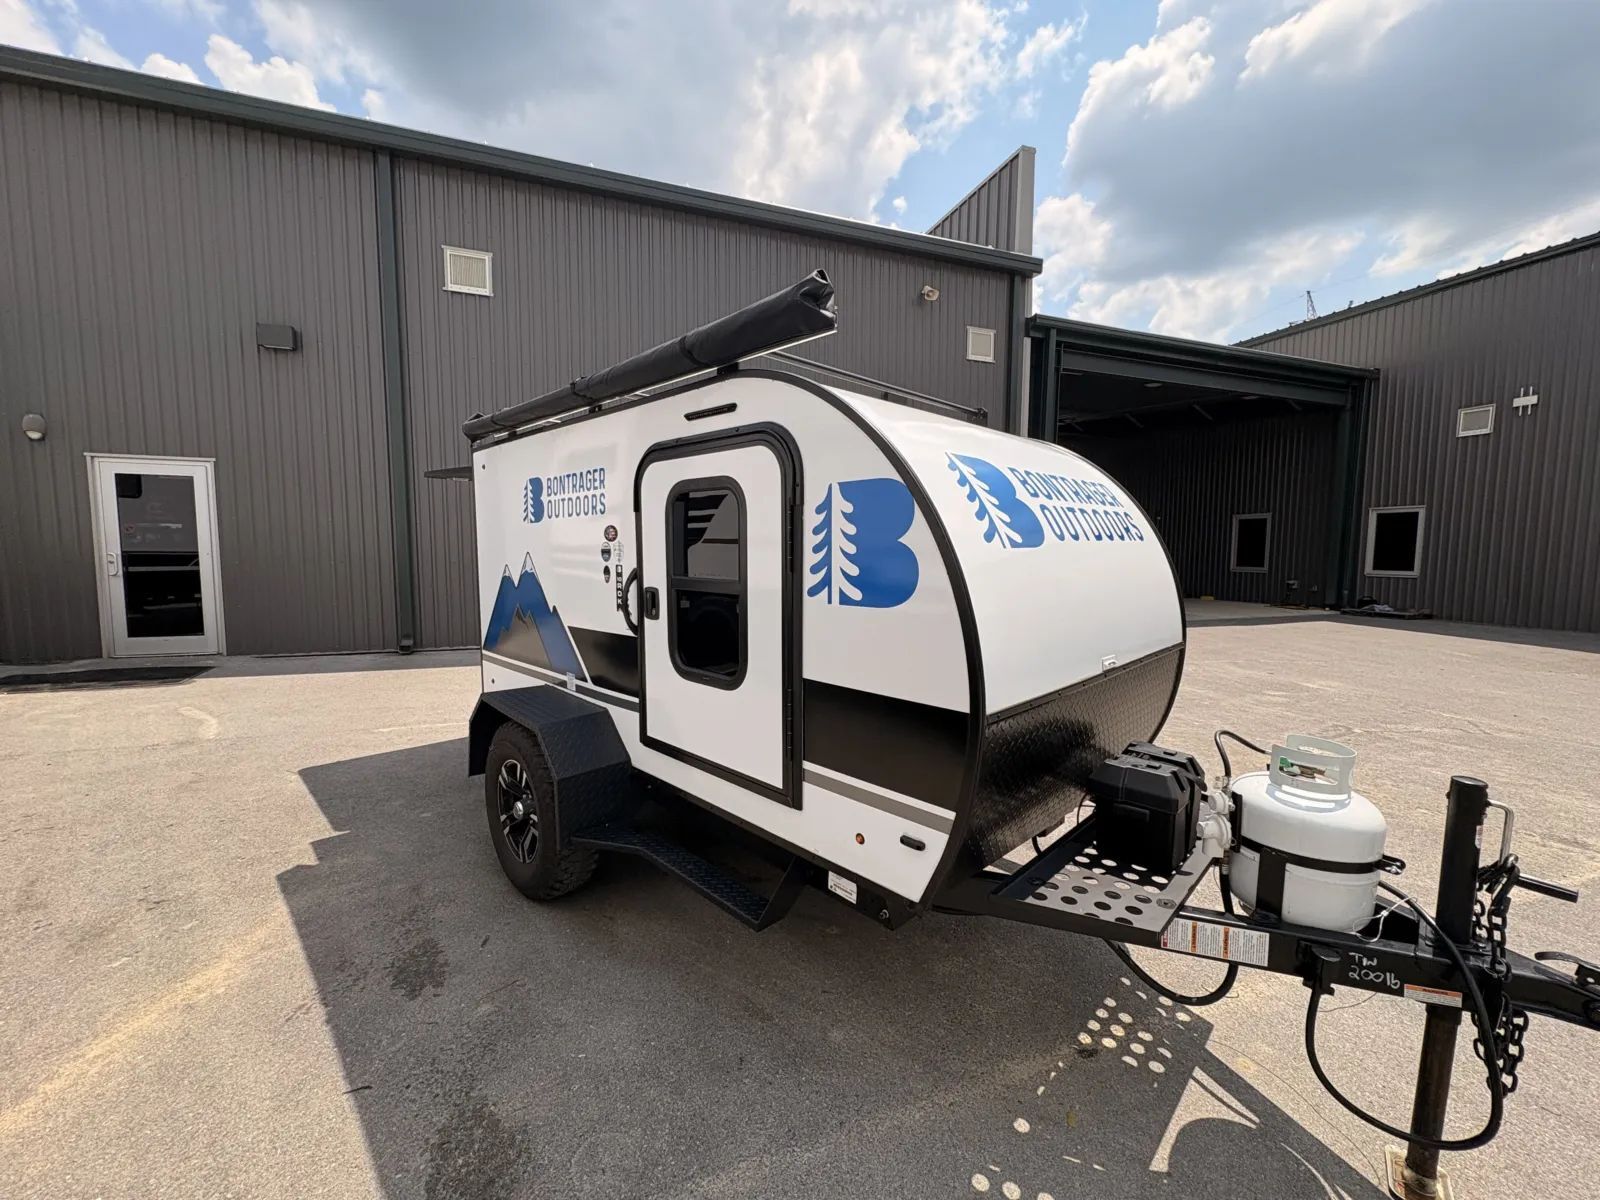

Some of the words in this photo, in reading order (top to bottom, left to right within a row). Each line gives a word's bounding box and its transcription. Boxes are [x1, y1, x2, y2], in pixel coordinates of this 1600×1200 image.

[546, 467, 606, 497] BONTRAGER
[1007, 466, 1124, 508] BONTRAGER
[546, 492, 606, 519] OUTDOORS
[1039, 504, 1145, 542] OUTDOORS
